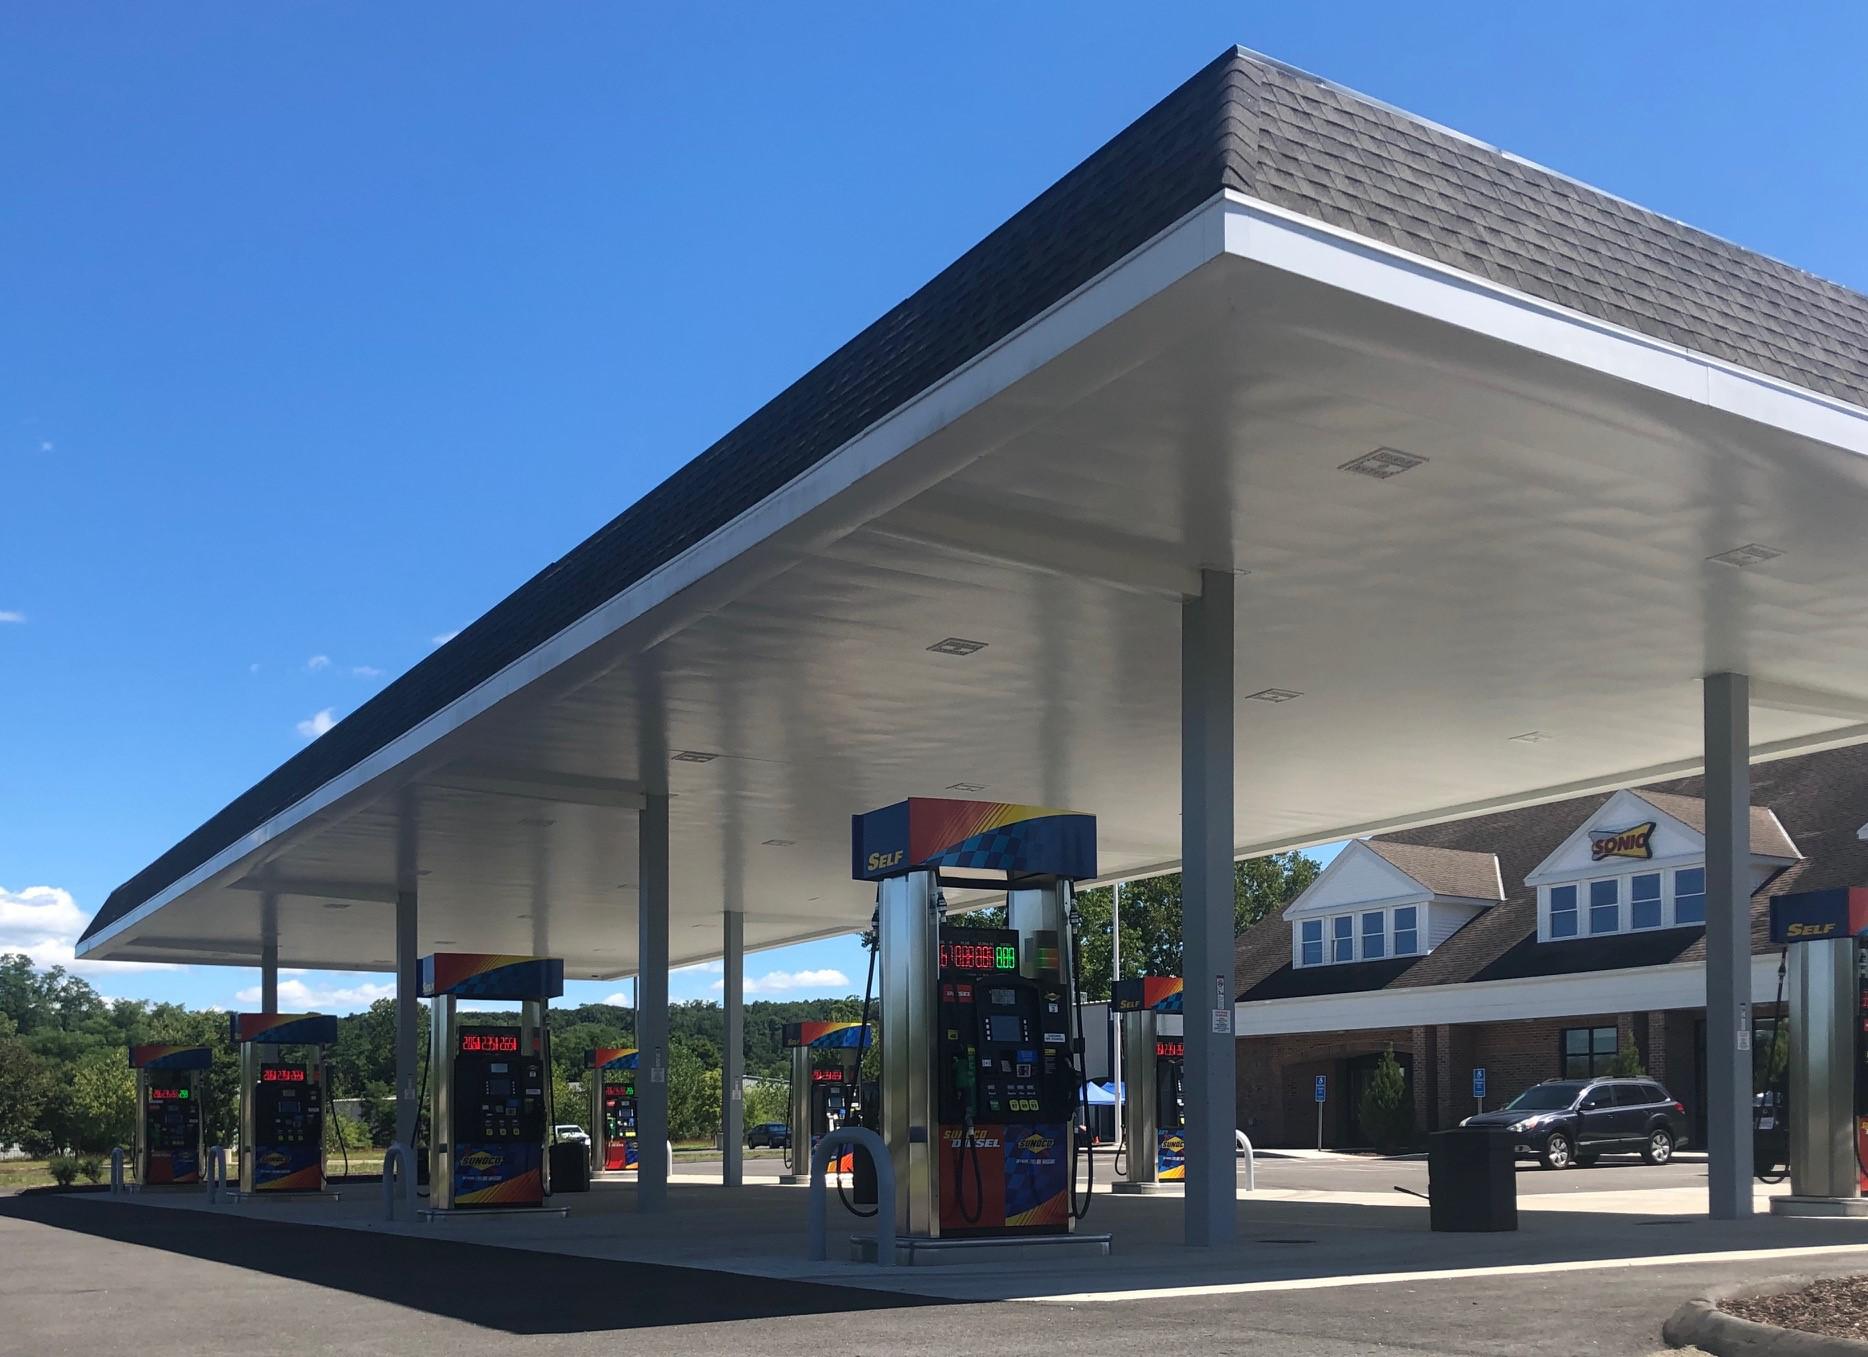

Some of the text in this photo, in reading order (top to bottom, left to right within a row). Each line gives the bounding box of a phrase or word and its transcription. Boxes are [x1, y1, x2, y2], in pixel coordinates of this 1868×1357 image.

[1592, 832, 1647, 855] SONIC
[867, 849, 904, 871] SELF
[1786, 923, 1837, 937] SELF
[943, 1129, 988, 1139] SUCO
[1018, 1138, 1055, 1149] SUNOCO
[462, 1156, 503, 1166] SUNOCO
